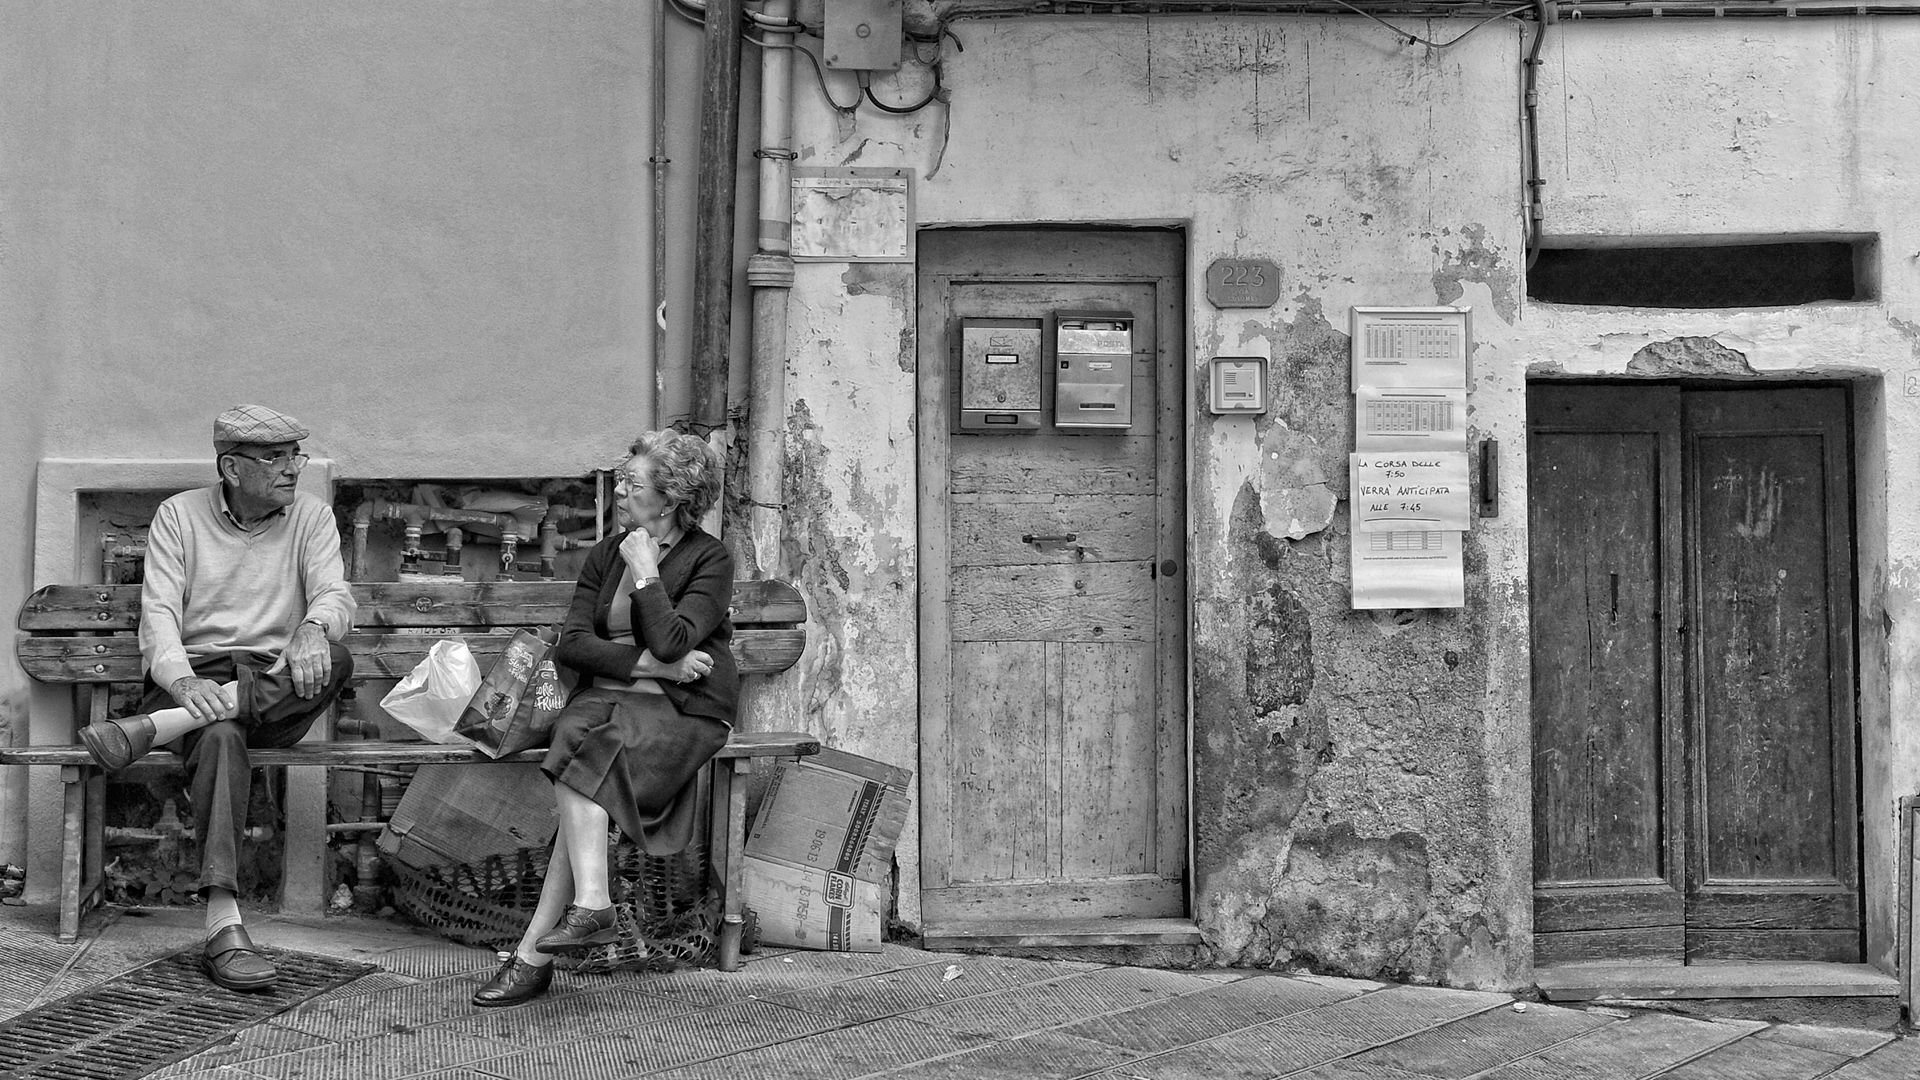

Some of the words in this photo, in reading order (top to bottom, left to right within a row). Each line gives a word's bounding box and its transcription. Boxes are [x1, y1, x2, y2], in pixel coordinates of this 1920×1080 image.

[1222, 266, 1265, 287] 223
[1358, 458, 1368, 468] LA
[1374, 460, 1407, 468] CORSA
[1411, 460, 1441, 468] DELLE
[1385, 470, 1406, 479] 7:50
[1370, 503, 1389, 513] ALLE
[1400, 502, 1422, 513] 7:45
[860, 798, 870, 816] ITALY
[828, 875, 838, 901] FLAKES
[835, 878, 844, 900] CORN
